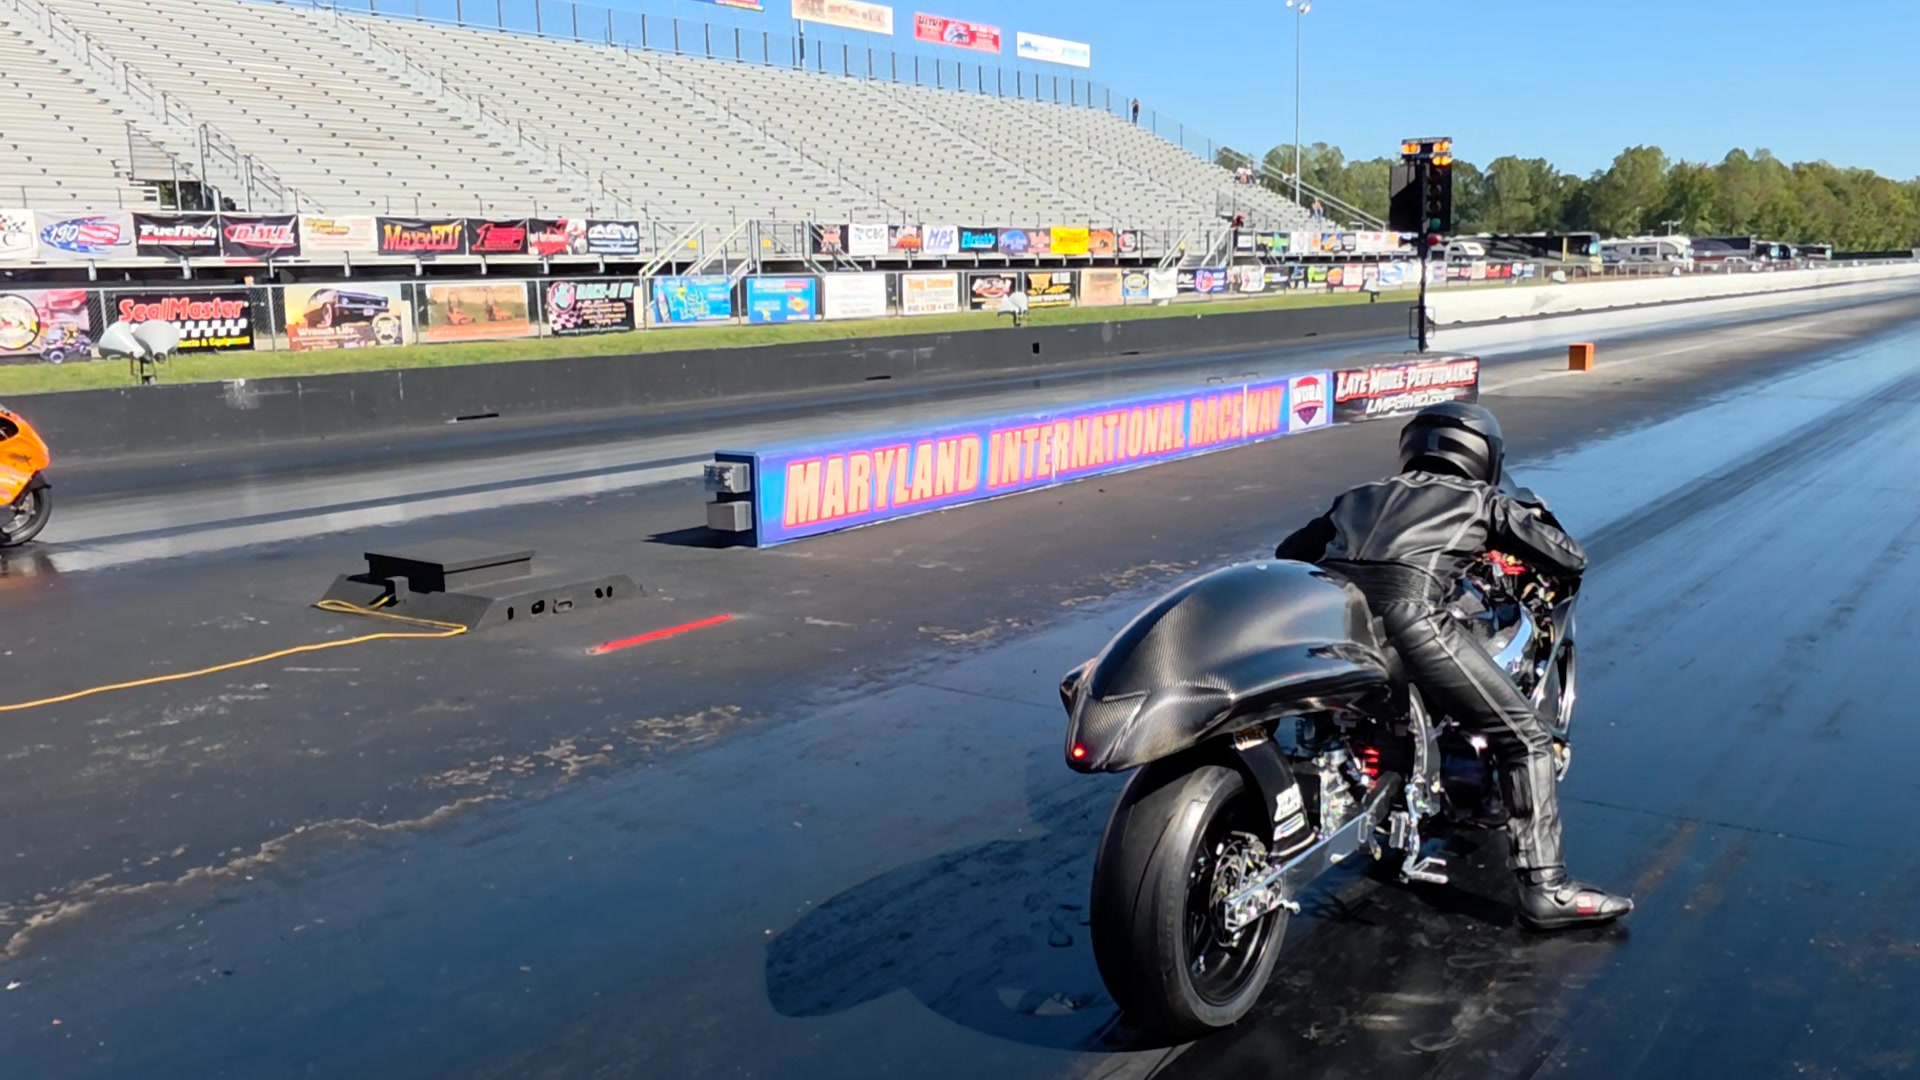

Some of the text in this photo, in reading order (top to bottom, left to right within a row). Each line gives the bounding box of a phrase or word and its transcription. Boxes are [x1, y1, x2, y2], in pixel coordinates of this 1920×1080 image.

[139, 225, 217, 239] FuelTech
[926, 228, 954, 249] MPS
[119, 297, 244, 322] SealMaster
[1335, 372, 1368, 402] LATE
[783, 385, 1285, 528] MARYLAND INTERNATIONAL RACEWAY
